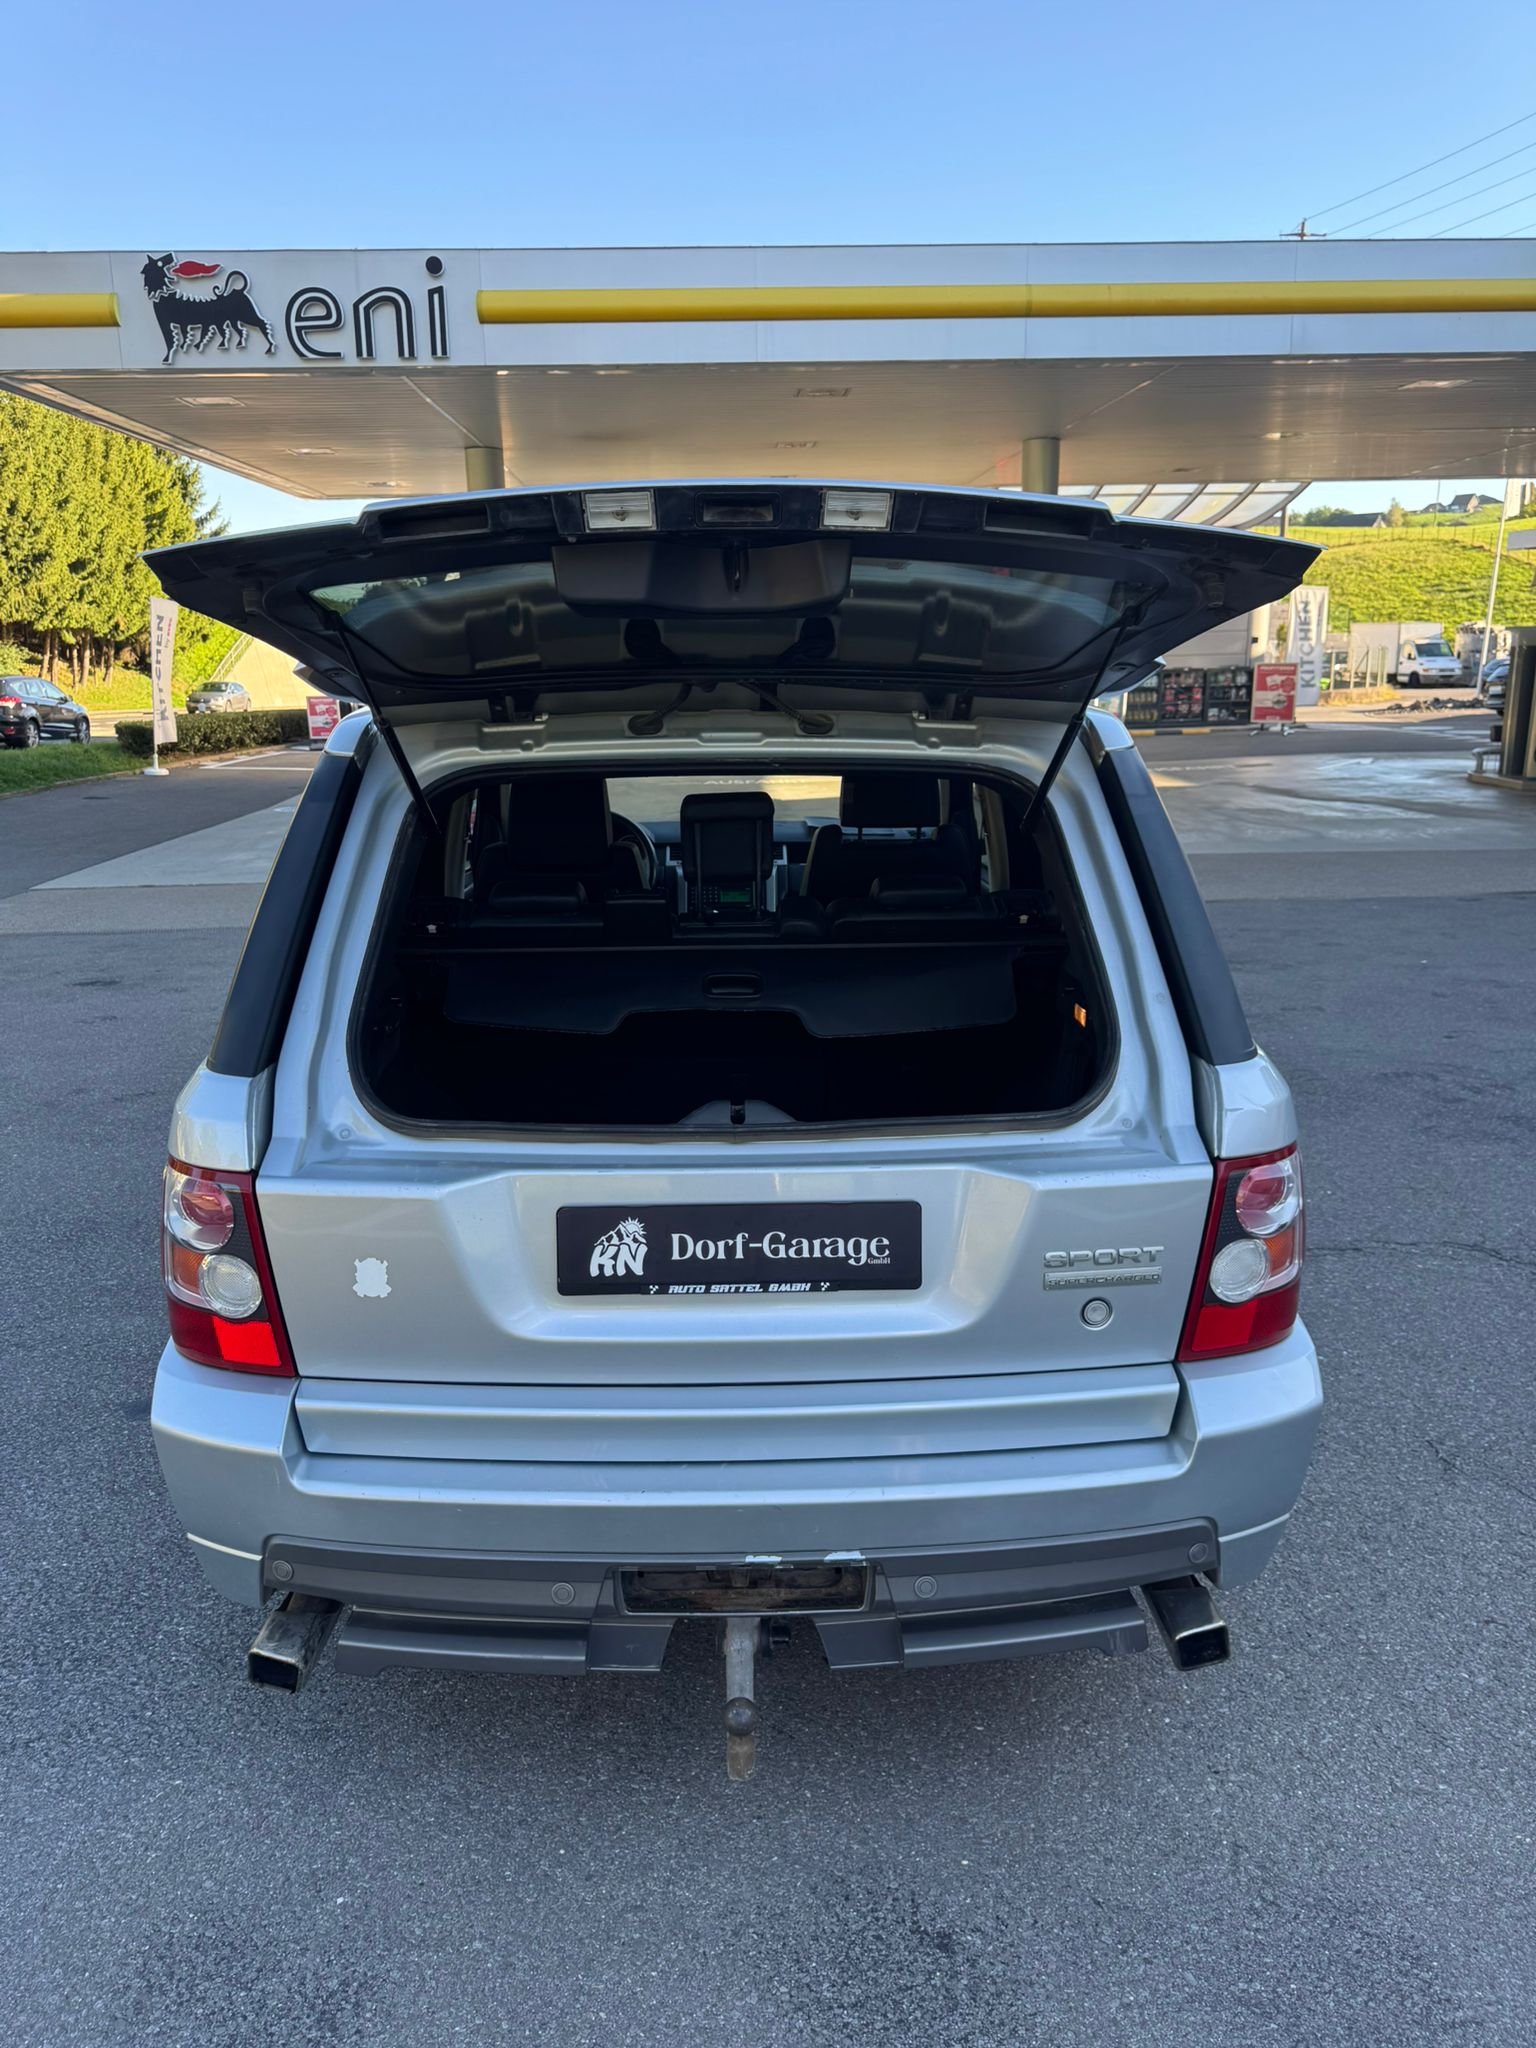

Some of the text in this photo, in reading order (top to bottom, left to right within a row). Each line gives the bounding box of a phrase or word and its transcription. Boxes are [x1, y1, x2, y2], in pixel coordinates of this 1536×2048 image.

[285, 256, 449, 359] eni
[1298, 600, 1316, 688] KITCHEN
[589, 1244, 648, 1277] KN
[671, 1231, 890, 1266] Dorf-Garage
[1043, 1246, 1165, 1268] SPORT
[668, 1284, 706, 1294] AUTO
[709, 1283, 764, 1293] SATTEL
